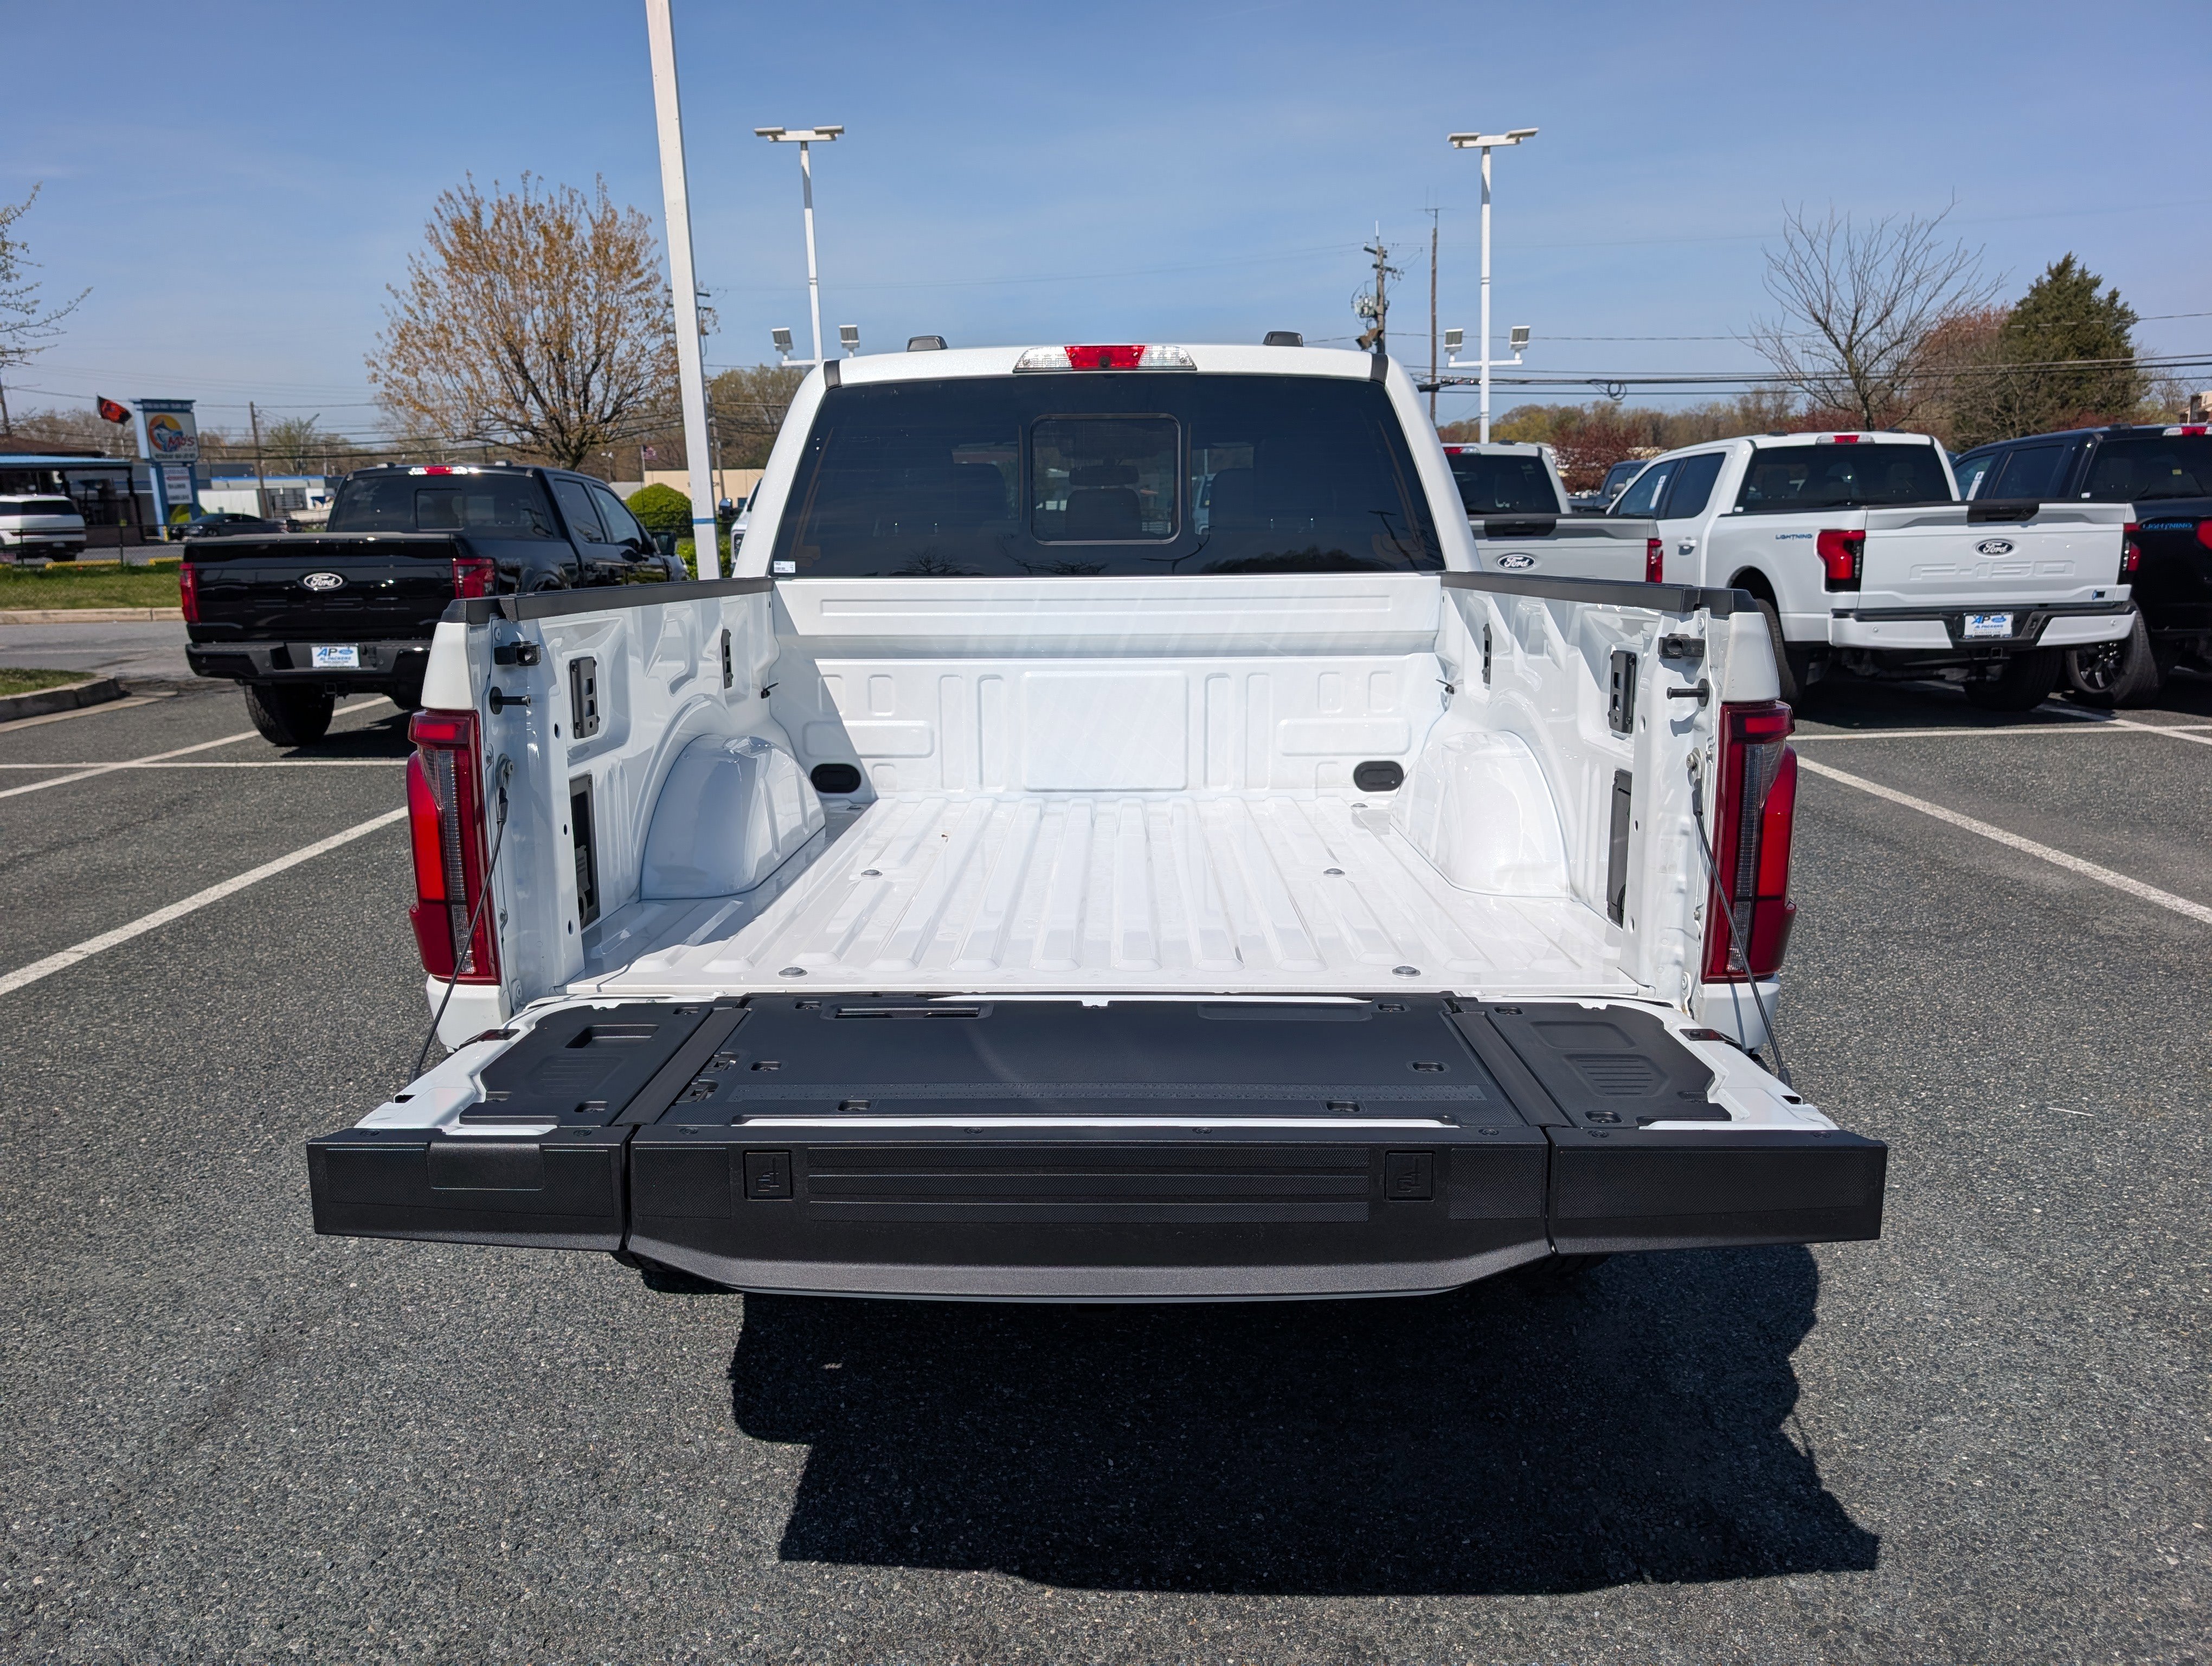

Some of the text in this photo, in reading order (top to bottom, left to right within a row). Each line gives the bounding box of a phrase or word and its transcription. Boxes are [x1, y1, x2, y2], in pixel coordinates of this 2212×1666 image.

[1983, 542, 2008, 553] Ford
[1504, 556, 1530, 567] Ford
[1909, 560, 2076, 581] F-150
[311, 575, 336, 586] Ford
[317, 648, 338, 656] AP
